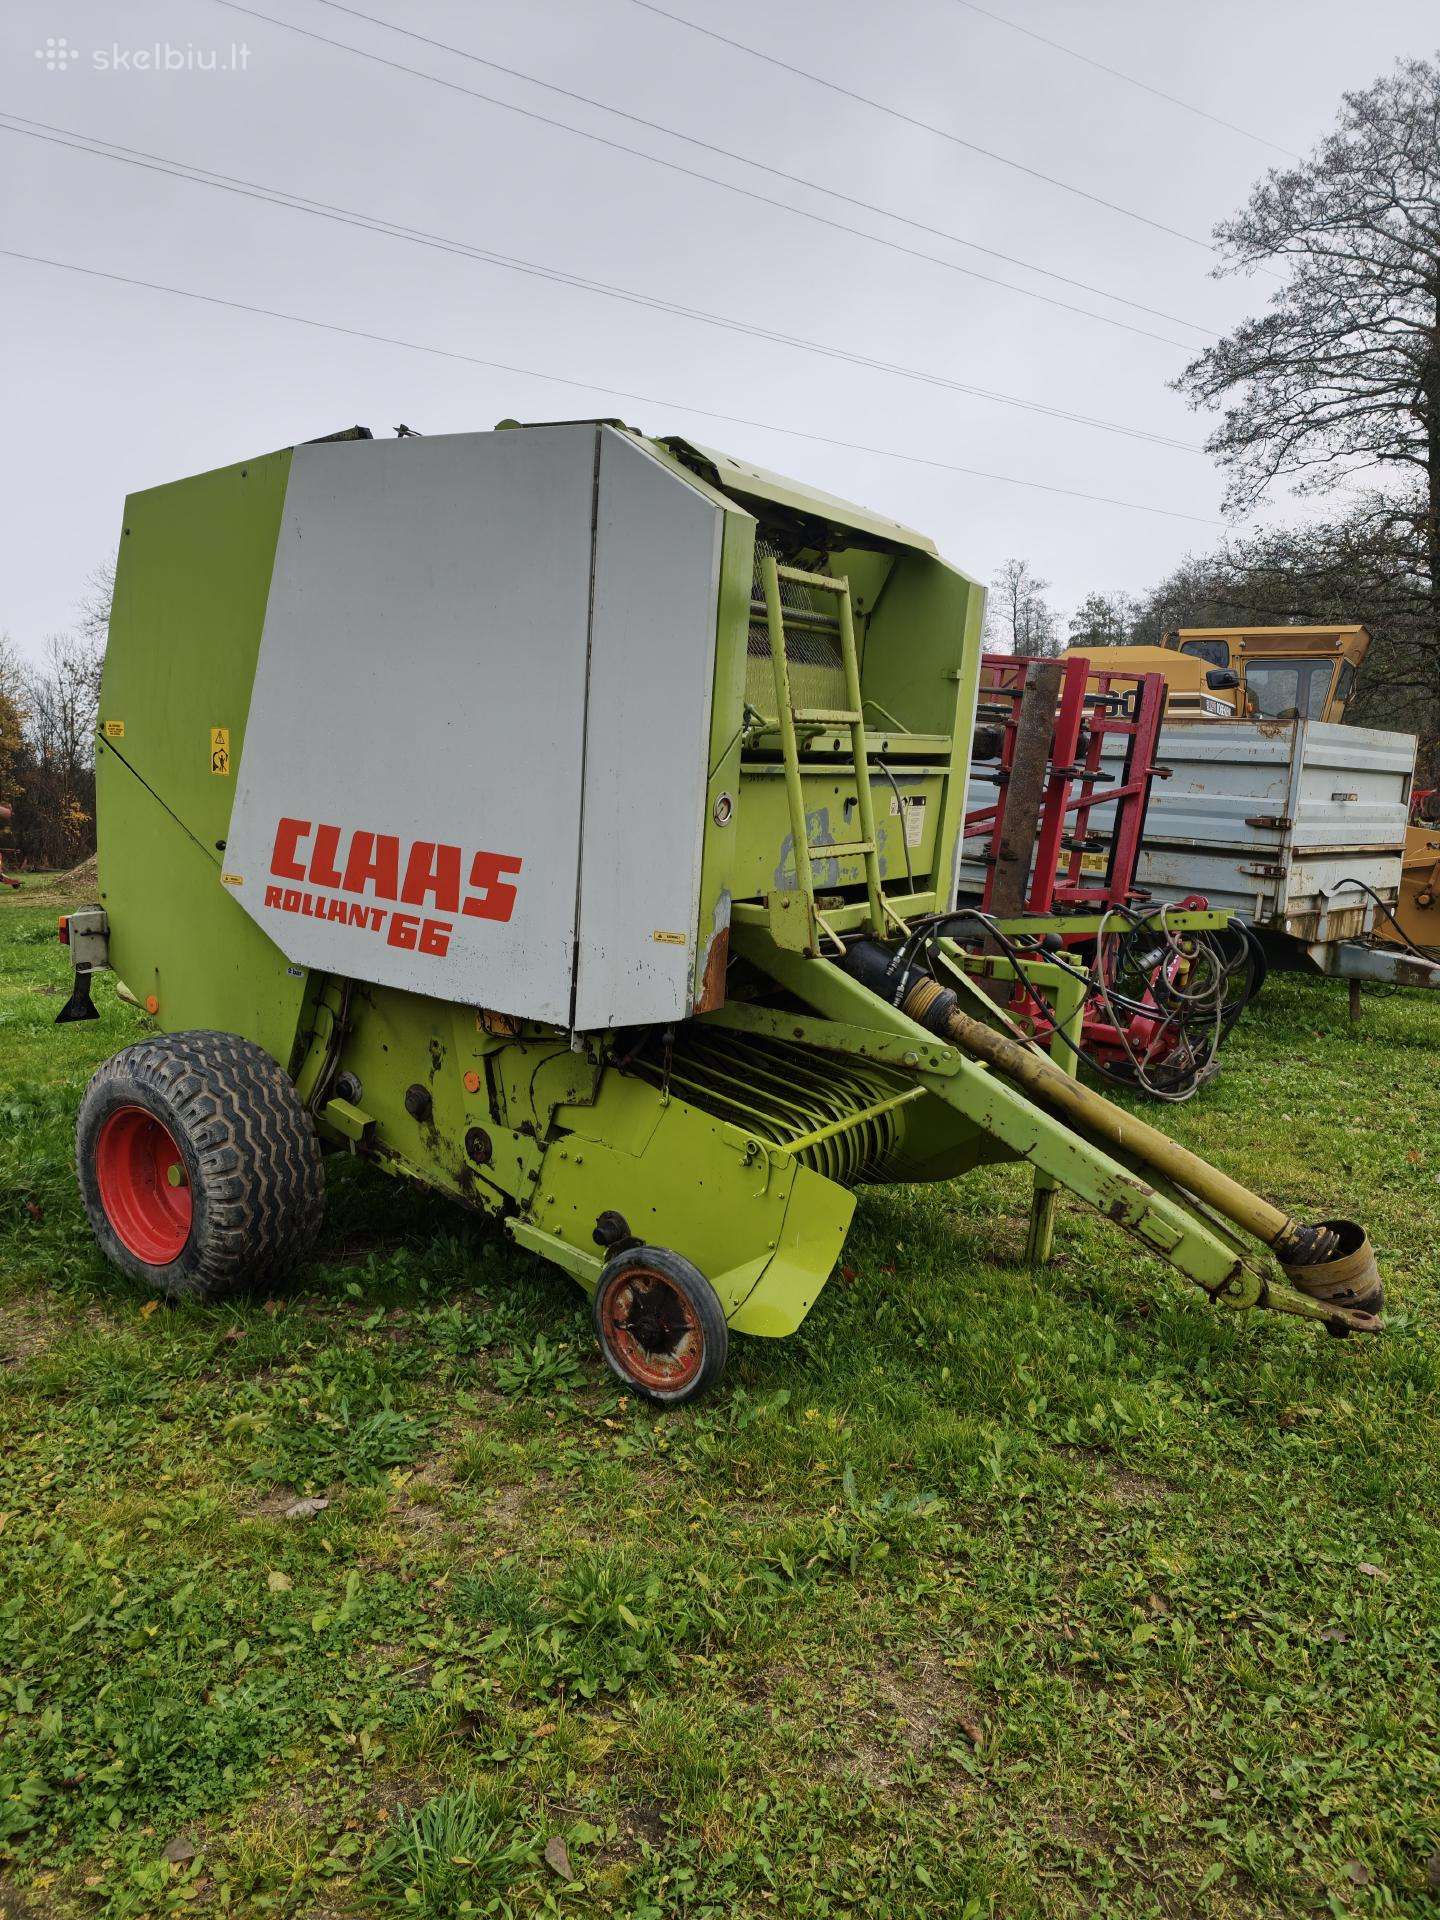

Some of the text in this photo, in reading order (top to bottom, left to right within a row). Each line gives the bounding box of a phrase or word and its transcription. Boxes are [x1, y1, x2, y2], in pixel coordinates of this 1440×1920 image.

[270, 817, 523, 923] CLAAS
[264, 885, 454, 958] ROLLANT 66
